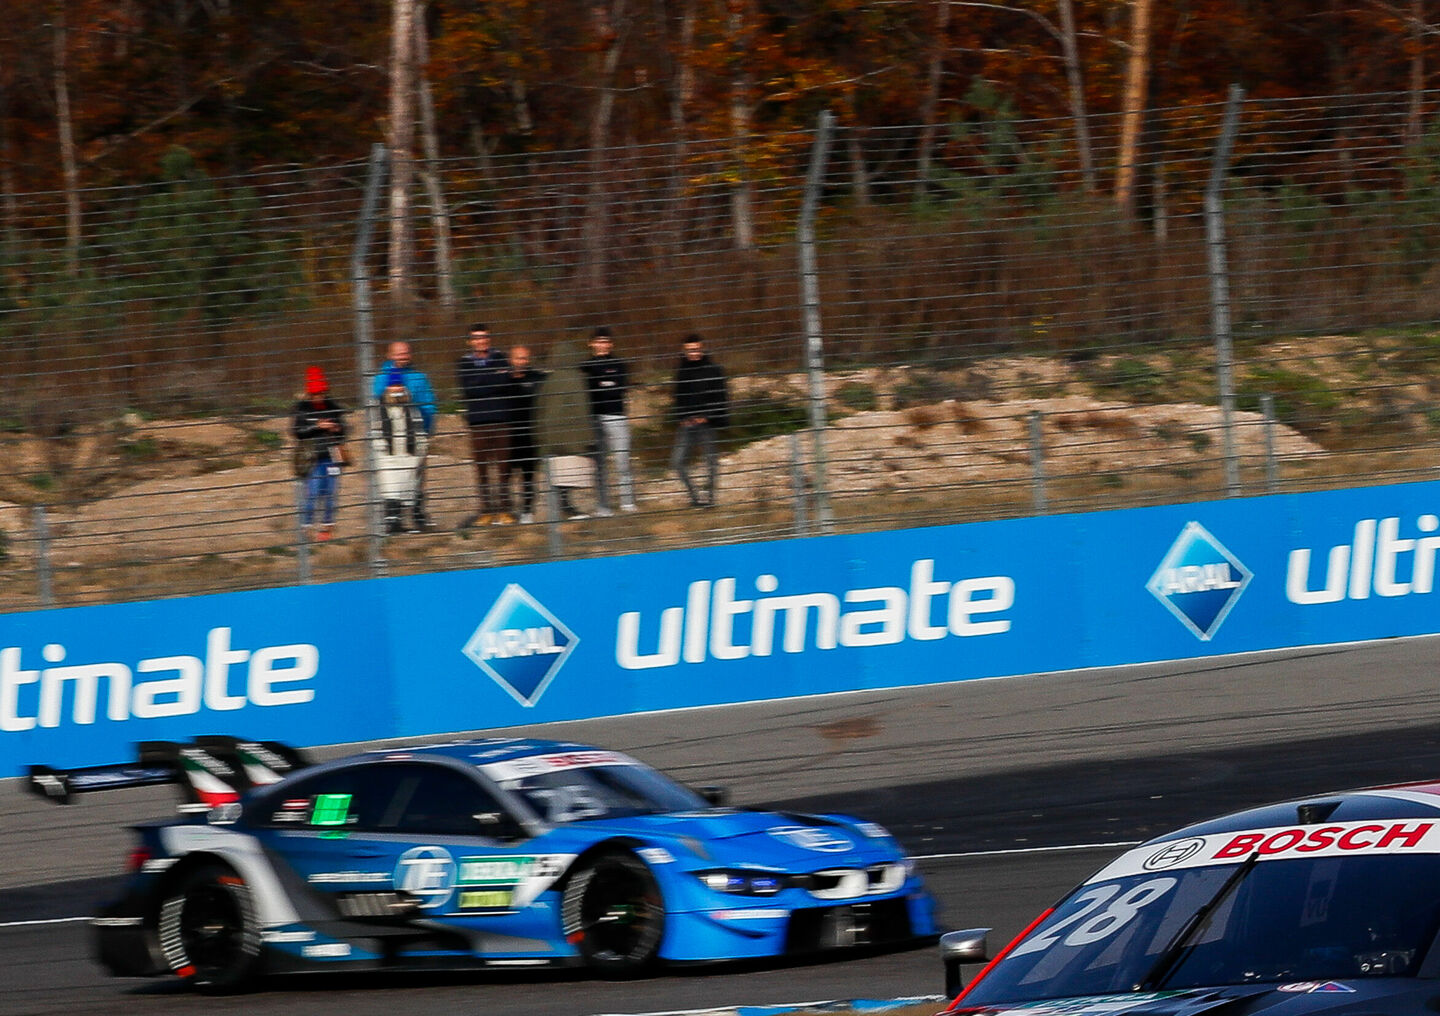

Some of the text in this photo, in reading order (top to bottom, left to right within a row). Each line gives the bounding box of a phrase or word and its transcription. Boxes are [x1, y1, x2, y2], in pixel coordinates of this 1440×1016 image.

[1165, 563, 1241, 595] ARAL
[616, 559, 1015, 669] ultimate
[481, 626, 567, 660] ARAL
[1211, 823, 1436, 860] BOSCH
[1006, 877, 1177, 960] 28
